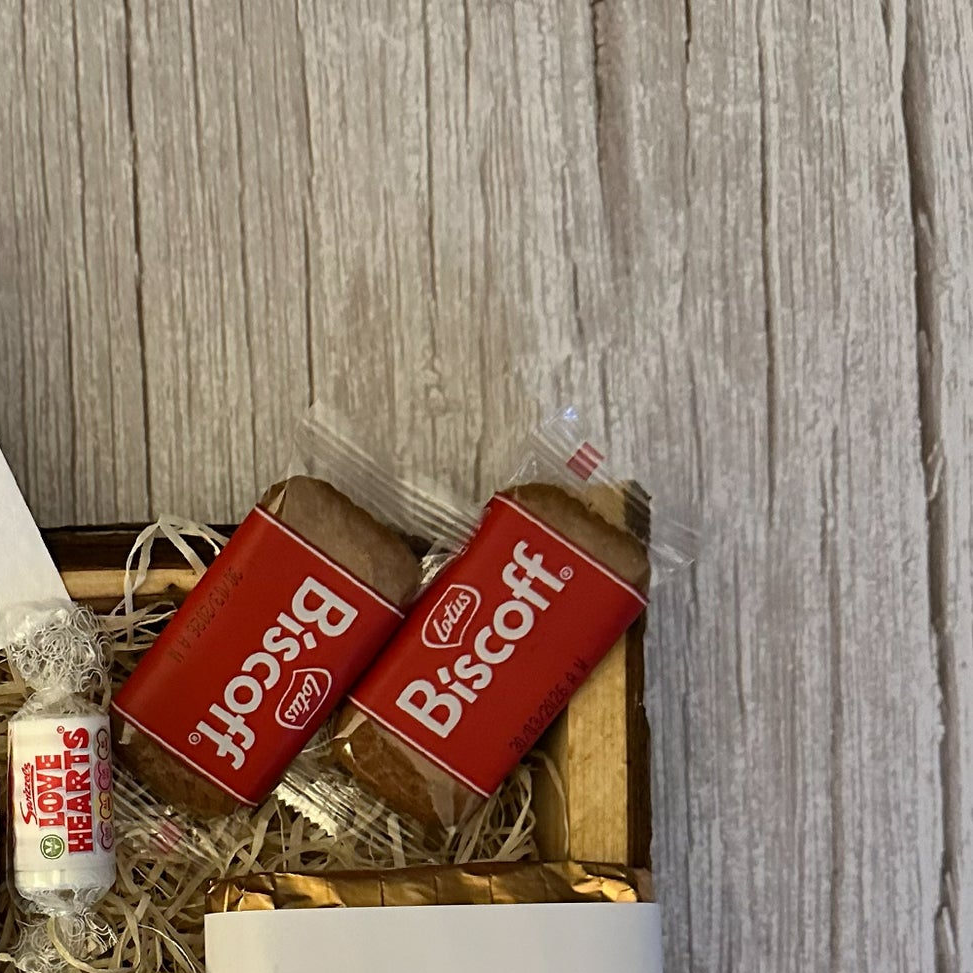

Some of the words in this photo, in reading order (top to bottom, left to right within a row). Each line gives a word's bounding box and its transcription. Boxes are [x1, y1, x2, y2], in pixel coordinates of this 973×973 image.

[395, 540, 566, 739] Biscoff
[433, 591, 472, 643] Lotus
[196, 576, 358, 770] Biscoff
[285, 673, 321, 722] Lotus
[35, 754, 65, 829] LOVE
[62, 727, 94, 855] HEARTS
